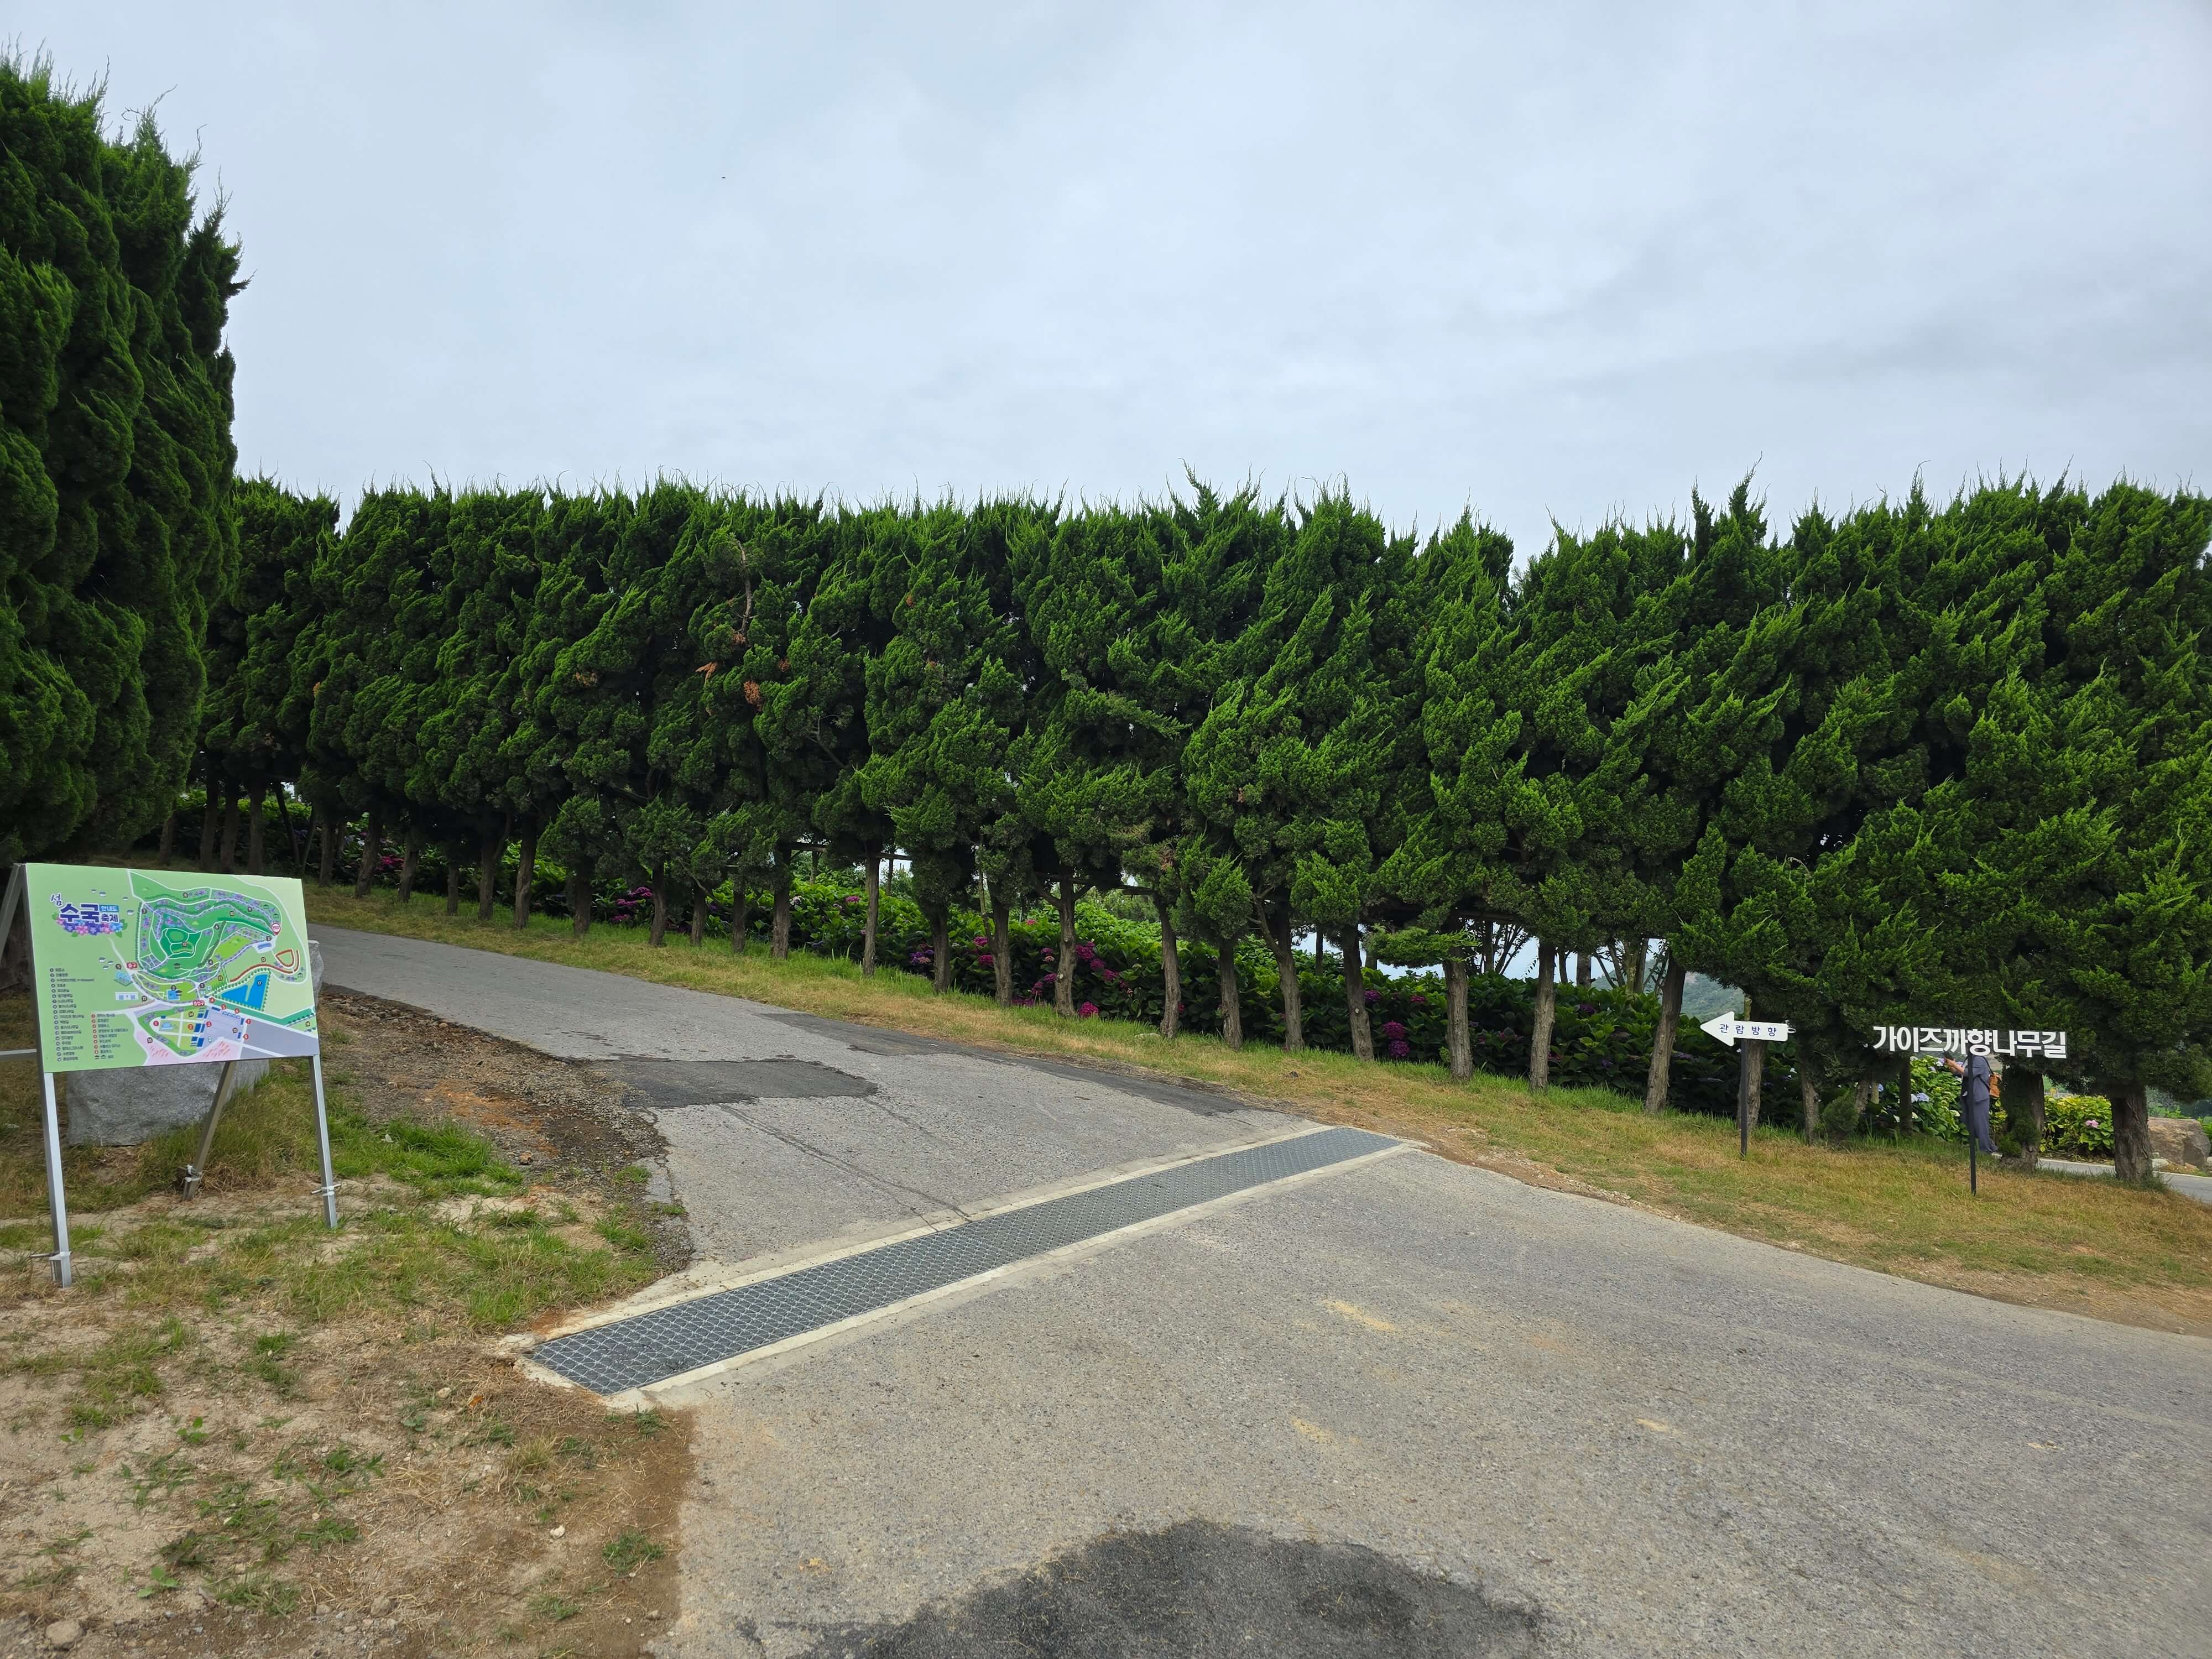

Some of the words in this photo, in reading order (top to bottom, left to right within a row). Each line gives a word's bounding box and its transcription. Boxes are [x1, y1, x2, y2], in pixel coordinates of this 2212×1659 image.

[50, 893, 62, 906] 섬
[60, 903, 100, 922] 수국
[101, 914, 118, 922] 축제
[1719, 1024, 1777, 1037] 관람방향
[1873, 1026, 2067, 1058] 가이즈까향나무길
